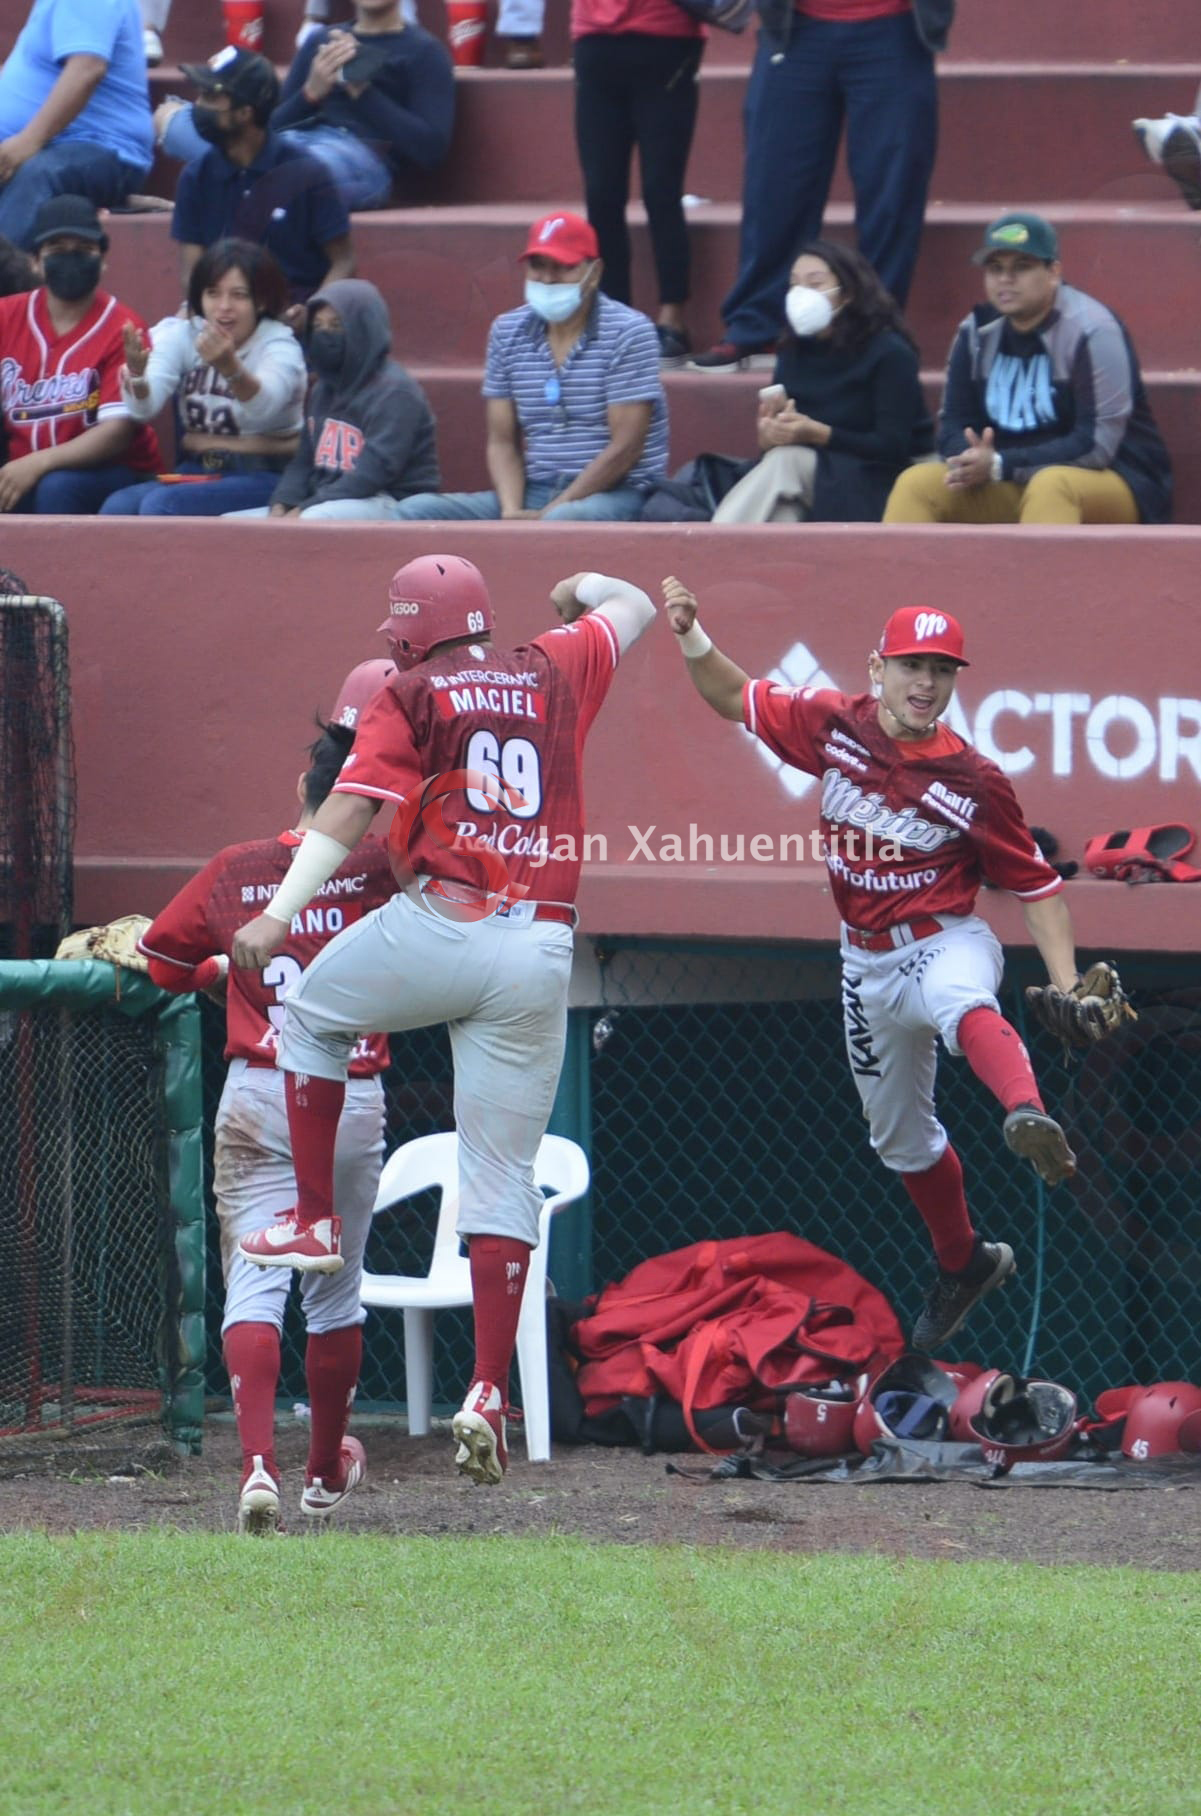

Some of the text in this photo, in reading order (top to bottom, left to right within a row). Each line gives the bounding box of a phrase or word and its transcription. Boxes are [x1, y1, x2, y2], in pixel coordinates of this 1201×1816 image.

[307, 416, 366, 472] AP
[467, 610, 485, 633] 69
[449, 686, 537, 719] MACIEL
[465, 728, 543, 821] 69
[821, 768, 960, 852] México
[834, 852, 938, 891] Profuturo
[1131, 1438, 1149, 1459] 45
